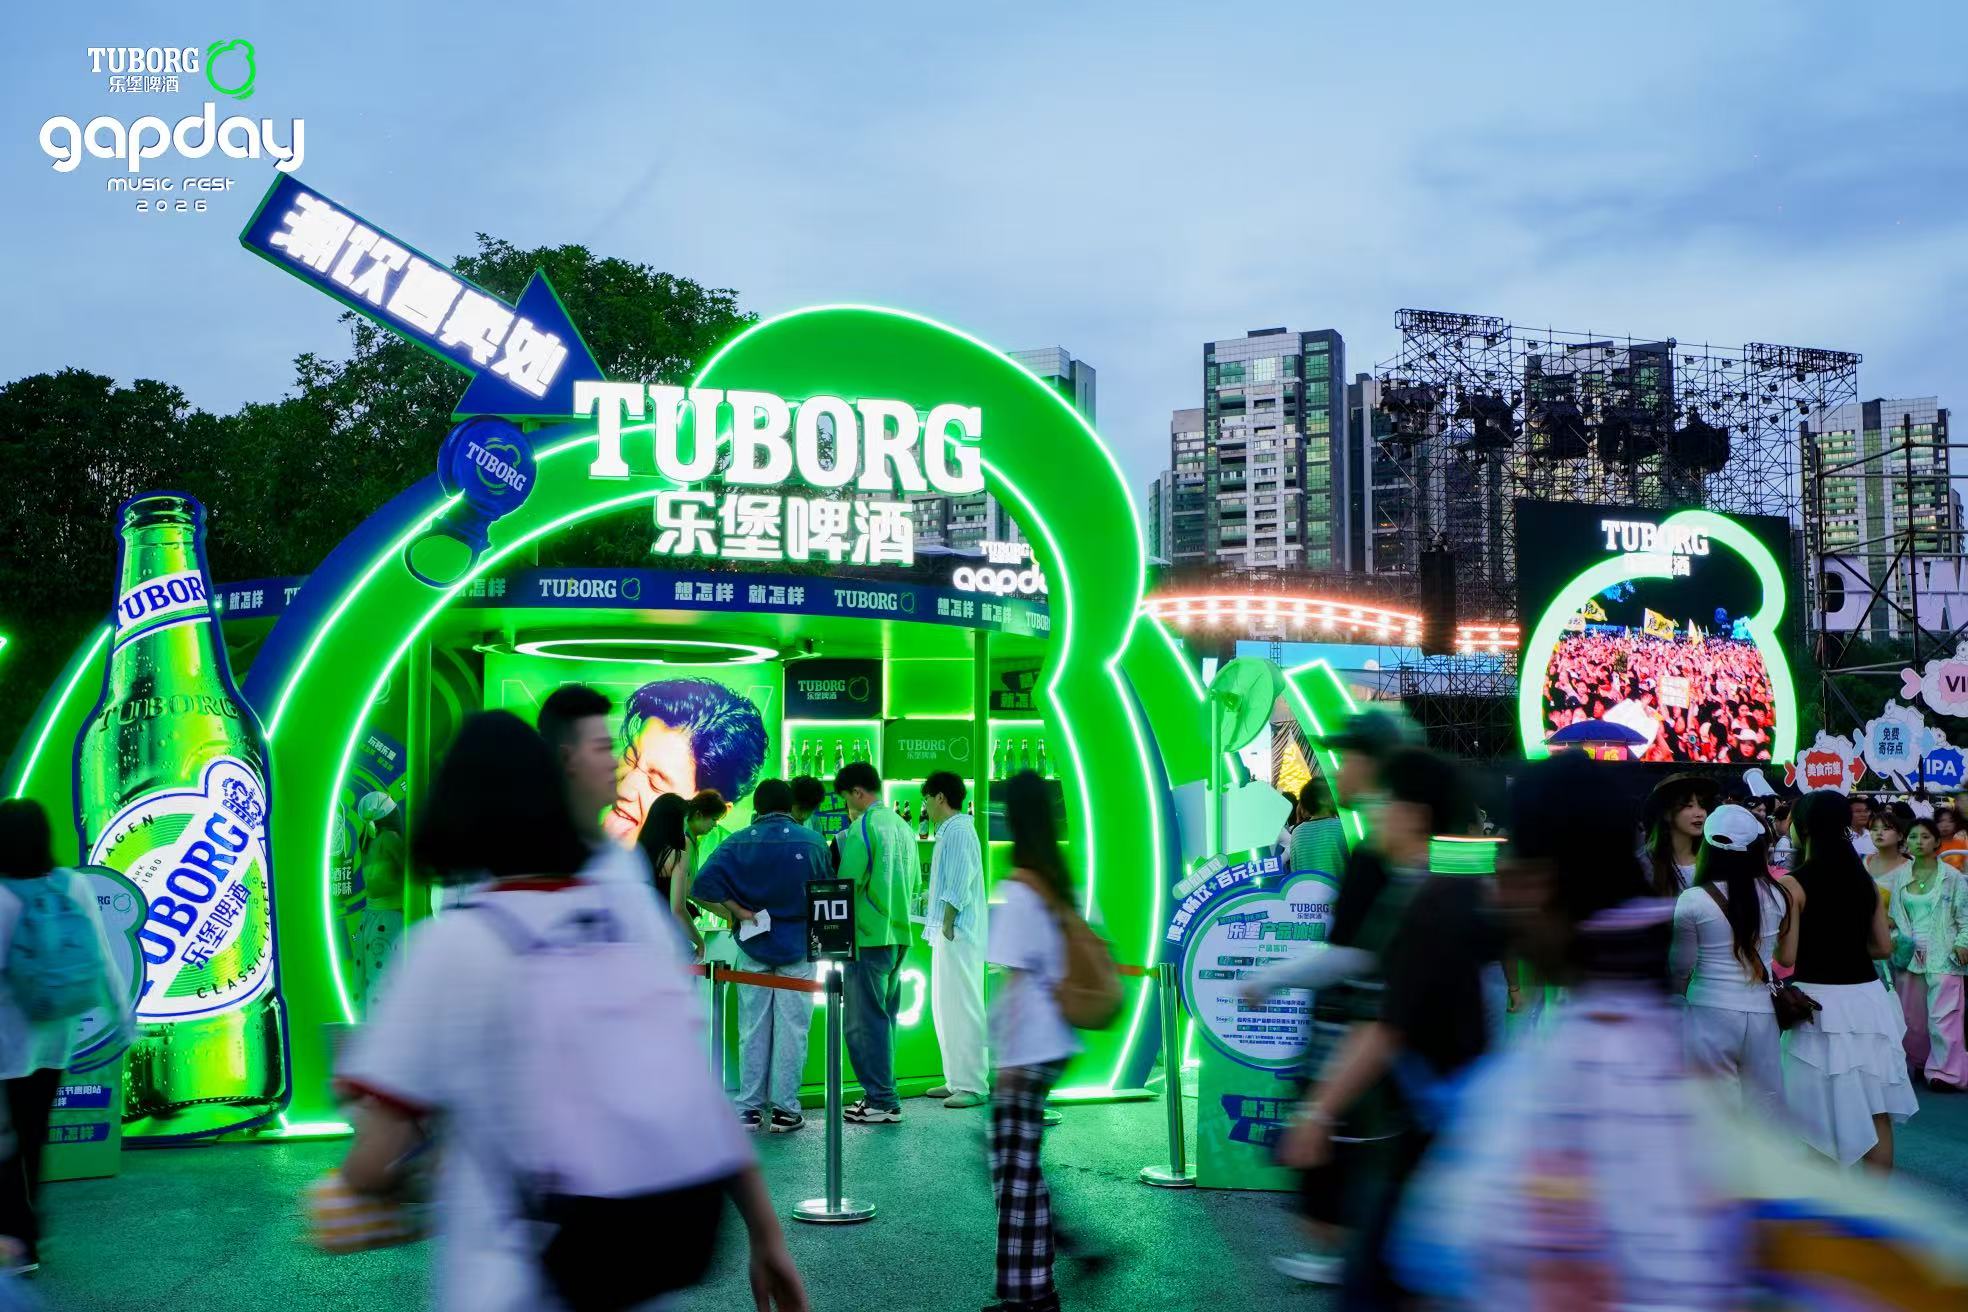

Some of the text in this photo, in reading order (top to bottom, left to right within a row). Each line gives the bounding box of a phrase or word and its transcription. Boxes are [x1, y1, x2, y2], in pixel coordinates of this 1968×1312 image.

[573, 380, 985, 494] TUBORG
[465, 441, 527, 492] TUBORG
[653, 490, 917, 566] 乐堡啤酒
[539, 578, 617, 599] TUBORG
[834, 589, 898, 611] TUBORG
[1025, 611, 1050, 631] TUBOR
[798, 680, 846, 692] TUBORG
[1945, 675, 1968, 693] VI
[1883, 727, 1900, 741] 免费
[898, 738, 946, 751] TUBORG
[1878, 741, 1904, 755] 寄存点
[1807, 763, 1842, 778] 美食市集
[1922, 758, 1958, 777] IPA
[138, 812, 250, 996] UBORG
[1290, 903, 1329, 913] TUBORG
[181, 879, 252, 971] 乐堡啤酒
[196, 947, 267, 999] CLASSIC
